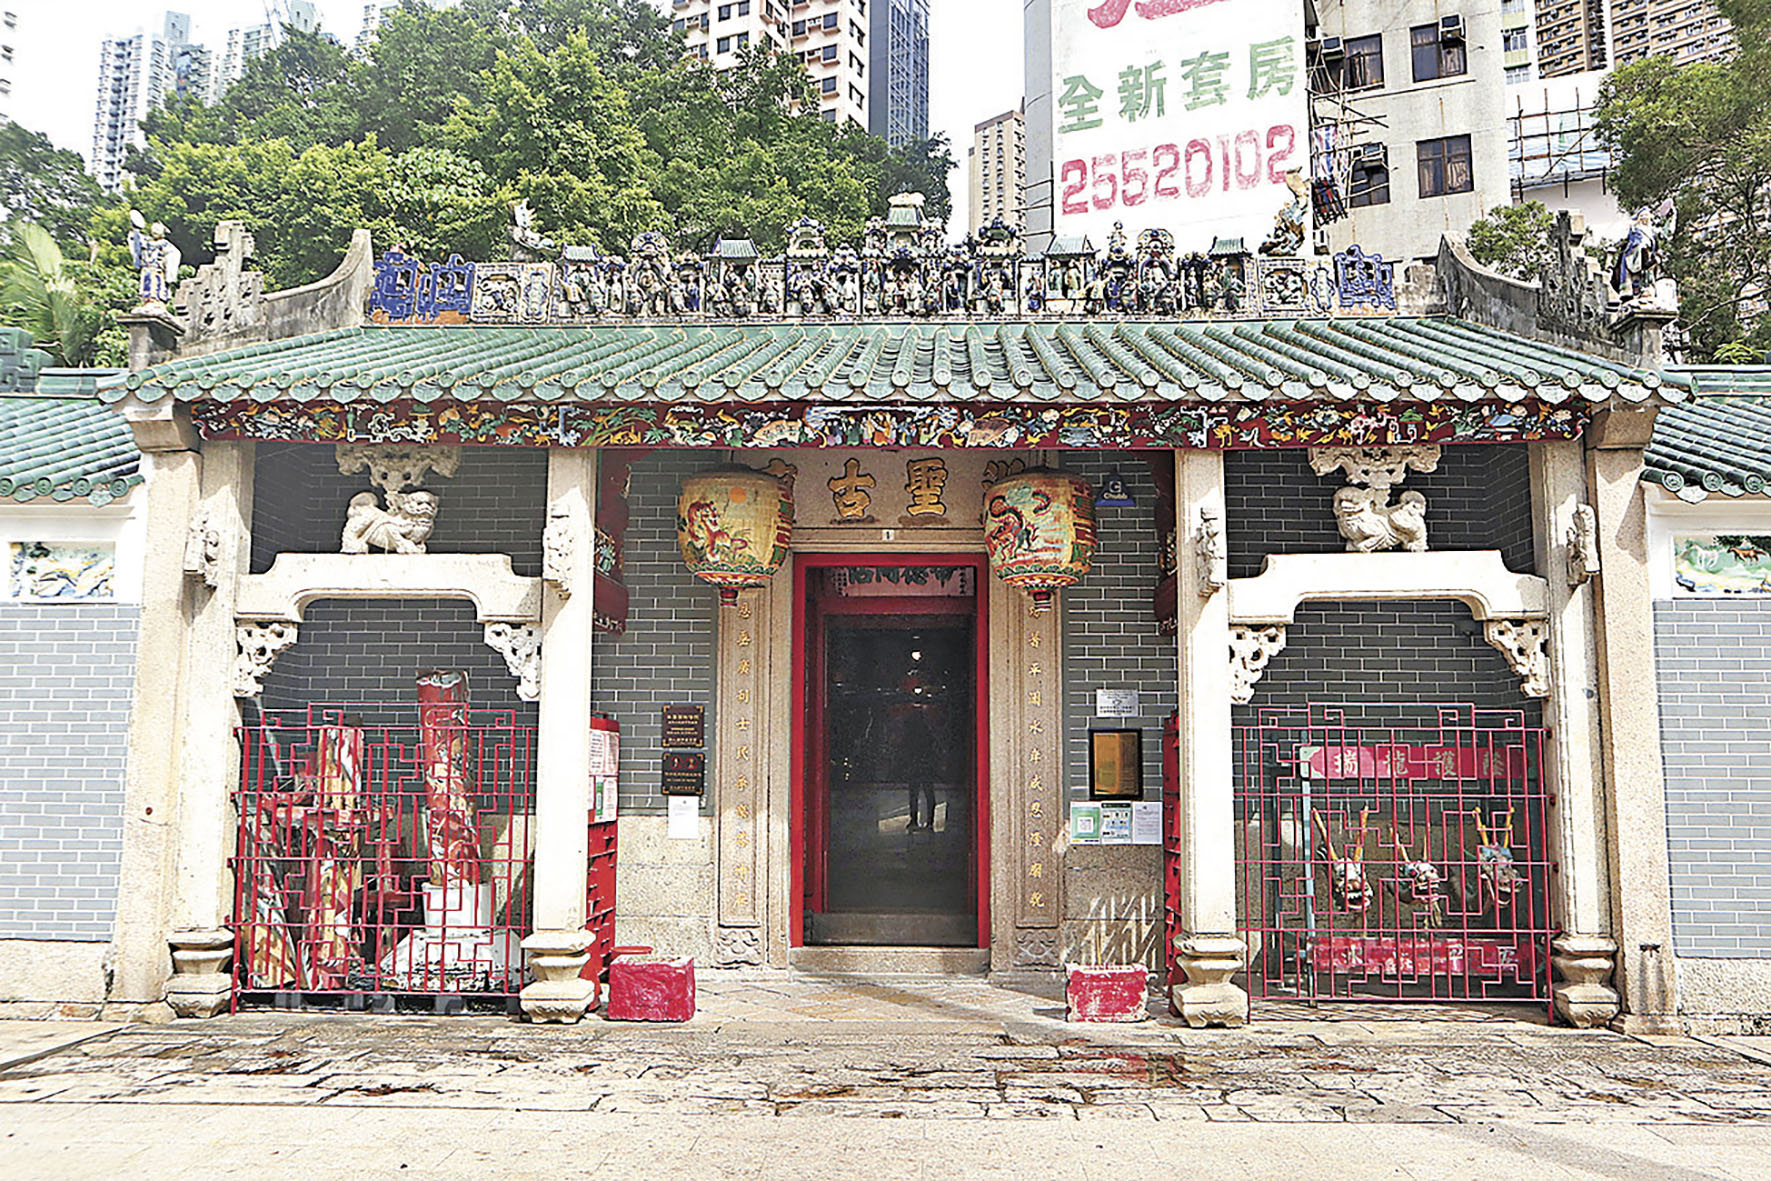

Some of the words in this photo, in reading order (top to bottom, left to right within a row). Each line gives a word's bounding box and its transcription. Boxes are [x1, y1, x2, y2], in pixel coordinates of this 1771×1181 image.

[1058, 35, 1297, 134] 全新套房
[1061, 124, 1296, 216] 25520102
